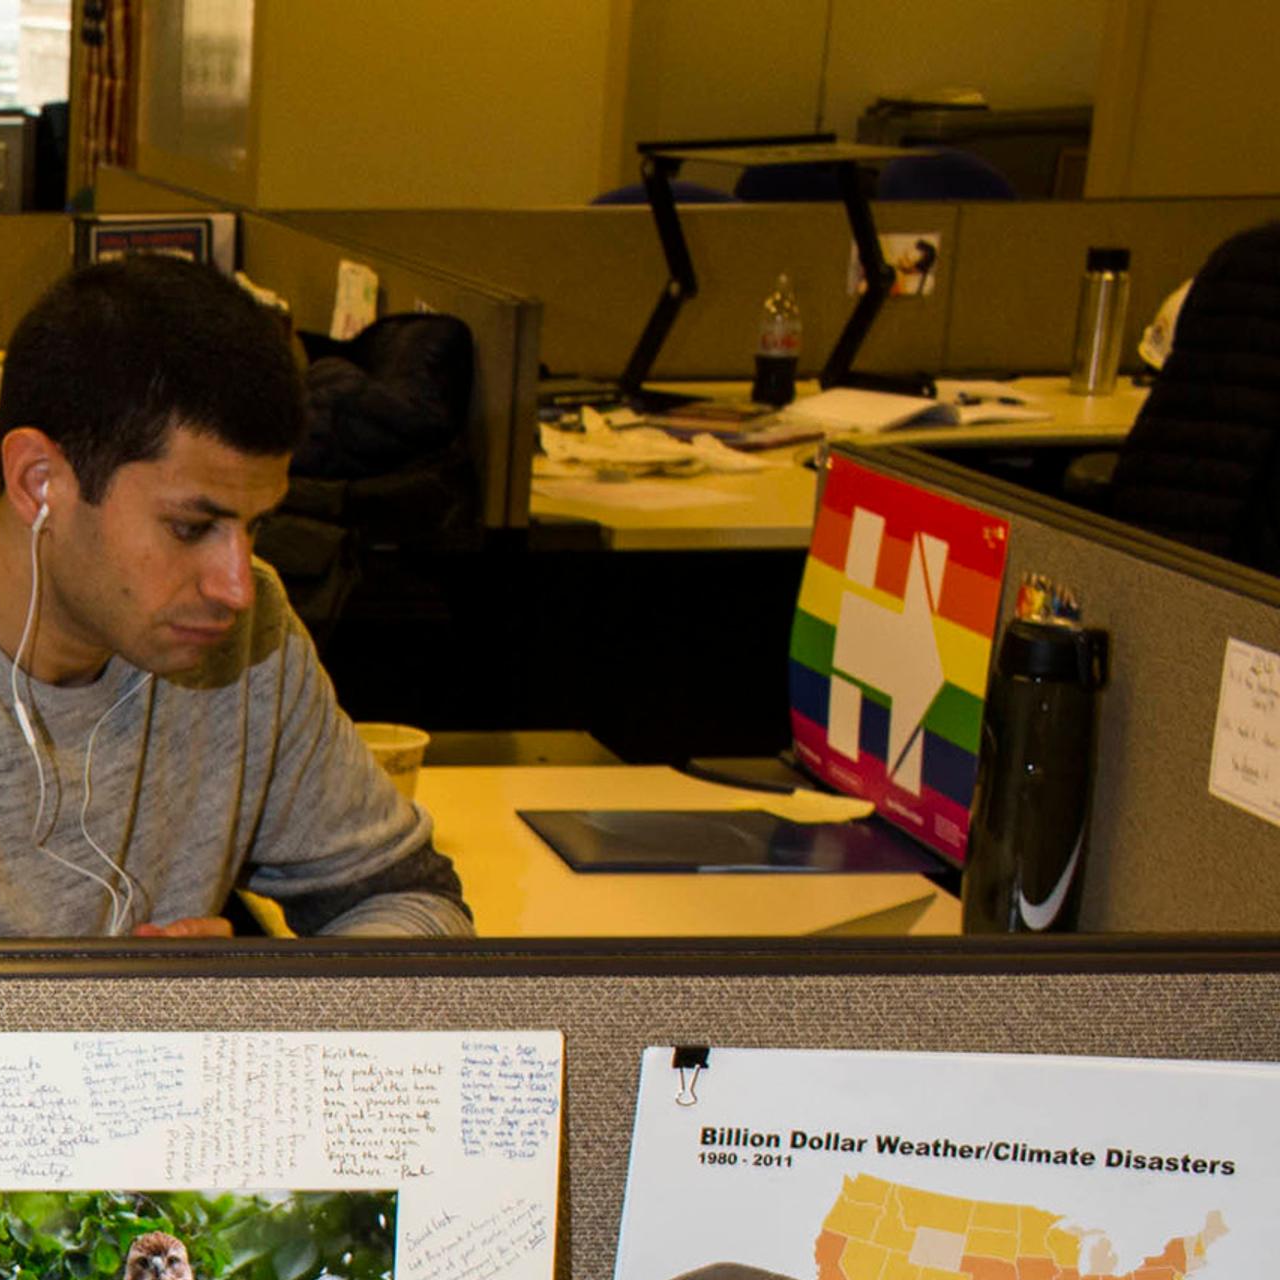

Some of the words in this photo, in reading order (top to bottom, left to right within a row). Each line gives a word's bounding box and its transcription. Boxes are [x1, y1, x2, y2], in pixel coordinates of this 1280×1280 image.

[698, 1152, 737, 1165] 1980
[752, 1153, 792, 1168] 2011
[700, 1127, 780, 1148] Billion
[790, 1130, 867, 1152] Dollar
[875, 1134, 1096, 1167] Weather/Climate
[1105, 1148, 1235, 1175] Disasters
